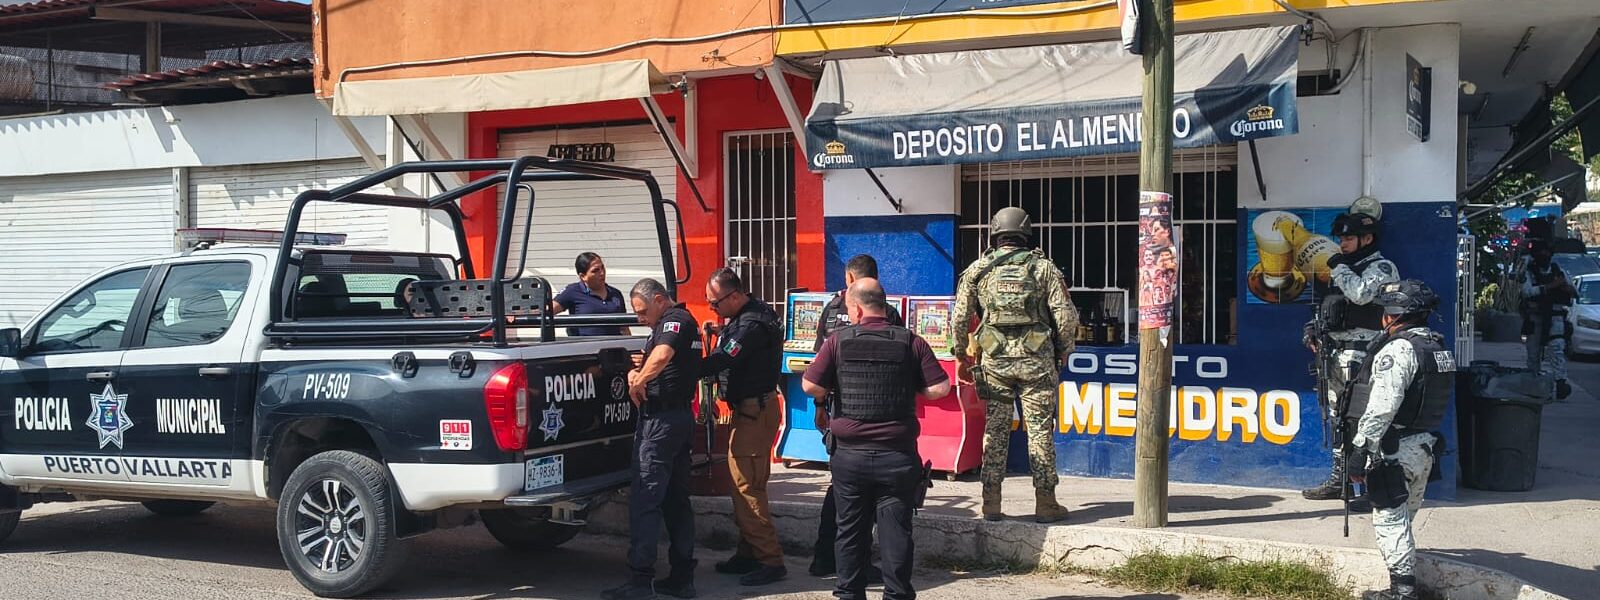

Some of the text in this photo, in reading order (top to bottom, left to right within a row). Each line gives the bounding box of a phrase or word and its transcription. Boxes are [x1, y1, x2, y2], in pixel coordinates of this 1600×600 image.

[893, 107, 1190, 160] DEPOSITO EL ALMENO
[1230, 118, 1284, 137] Corona
[813, 152, 854, 168] Corona
[302, 373, 351, 400] PV-509
[545, 373, 596, 402] POLICIA
[15, 397, 226, 434] POLICIA MUNICIPAL
[604, 402, 631, 424] PV-509
[443, 423, 470, 433] 911
[44, 456, 231, 479] PUERTO VALLARTA
